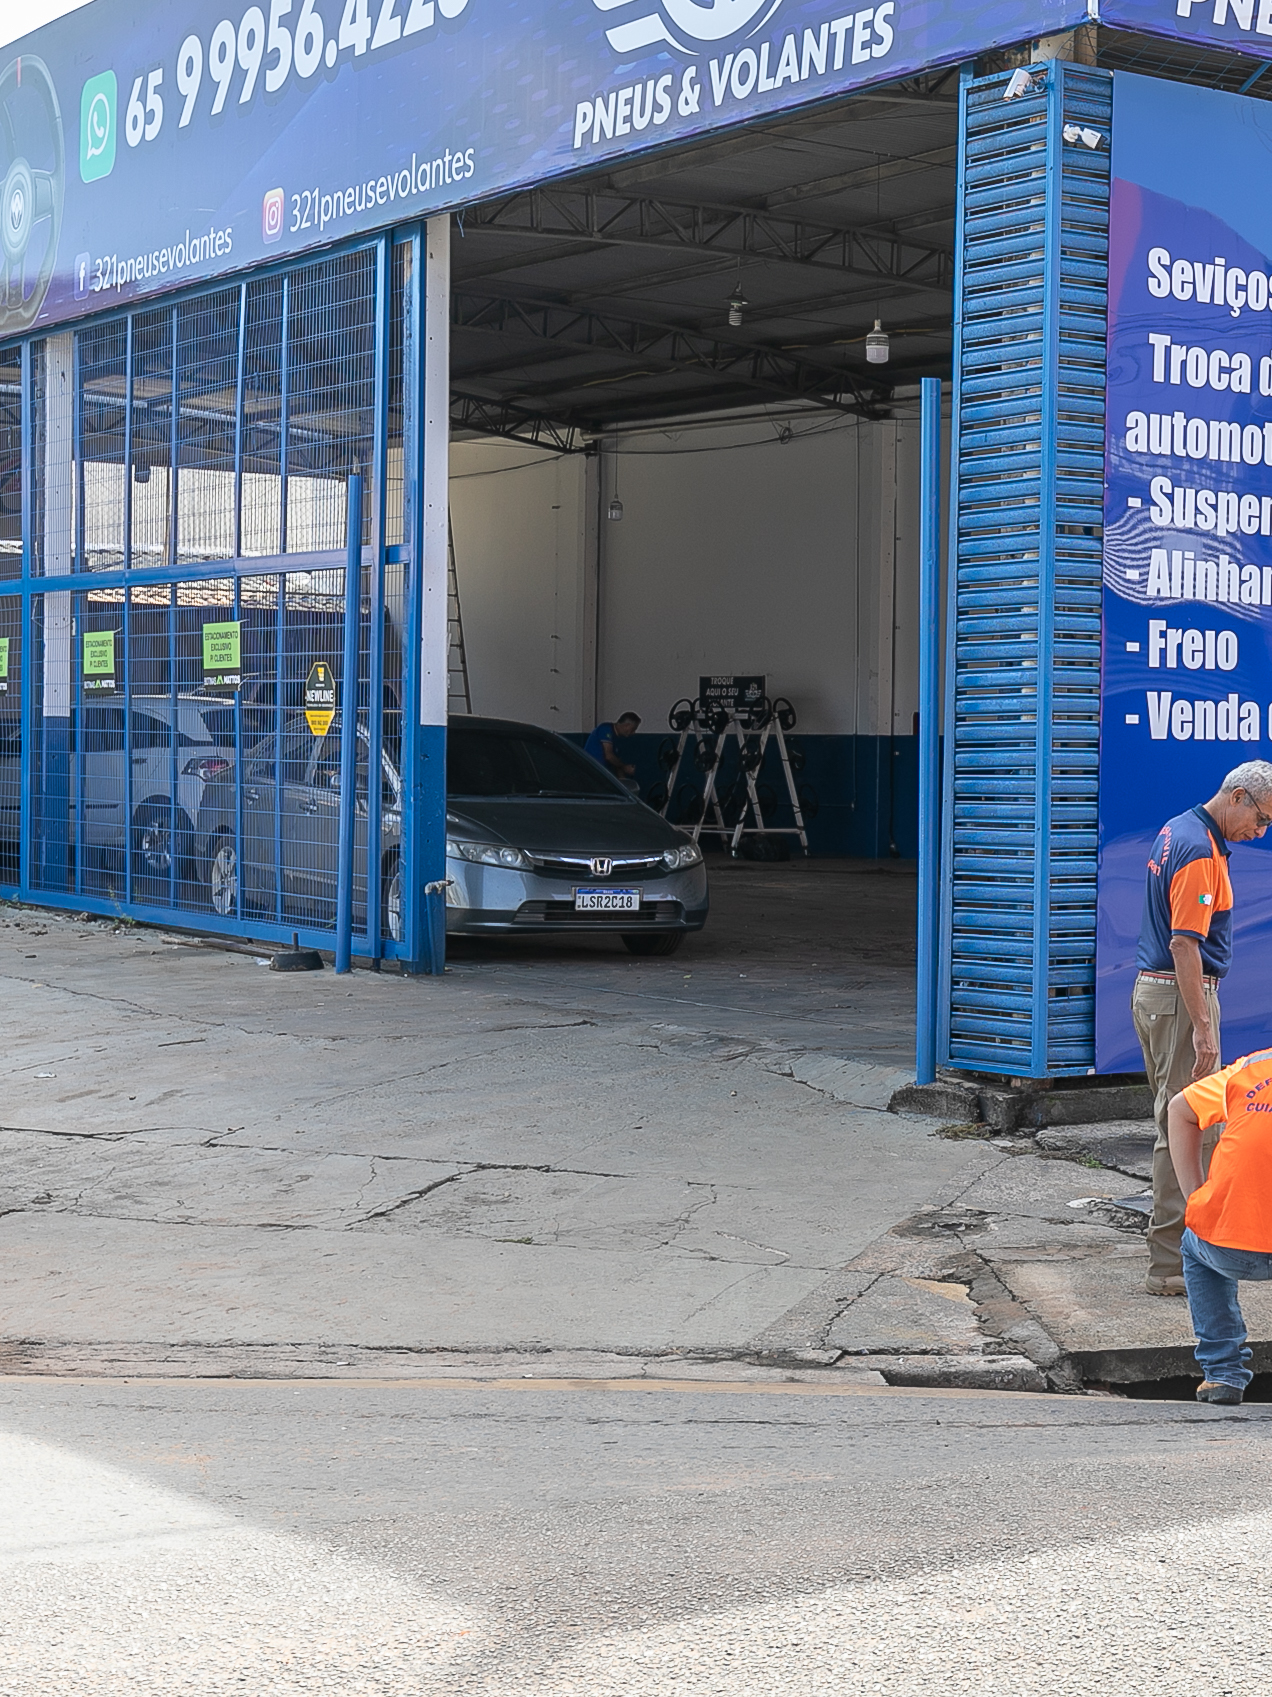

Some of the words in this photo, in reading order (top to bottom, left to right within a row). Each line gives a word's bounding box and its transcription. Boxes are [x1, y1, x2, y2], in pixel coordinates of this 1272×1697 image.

[574, 75, 672, 148] PNEUS
[678, 66, 700, 116] &
[708, 2, 894, 107] VOLANTES
[125, 68, 163, 147] 65
[290, 147, 475, 233] 321pneusevolantes
[93, 226, 233, 293] 321pneusevolantes
[1148, 332, 1251, 394] Troca
[306, 690, 334, 702] NEWLINE
[706, 688, 721, 697] AQUI
[722, 688, 727, 696] O
[728, 688, 739, 696] SEU
[711, 677, 734, 686] TROQUE
[1146, 691, 1260, 741] Venda
[581, 895, 633, 909] LSR2C18
